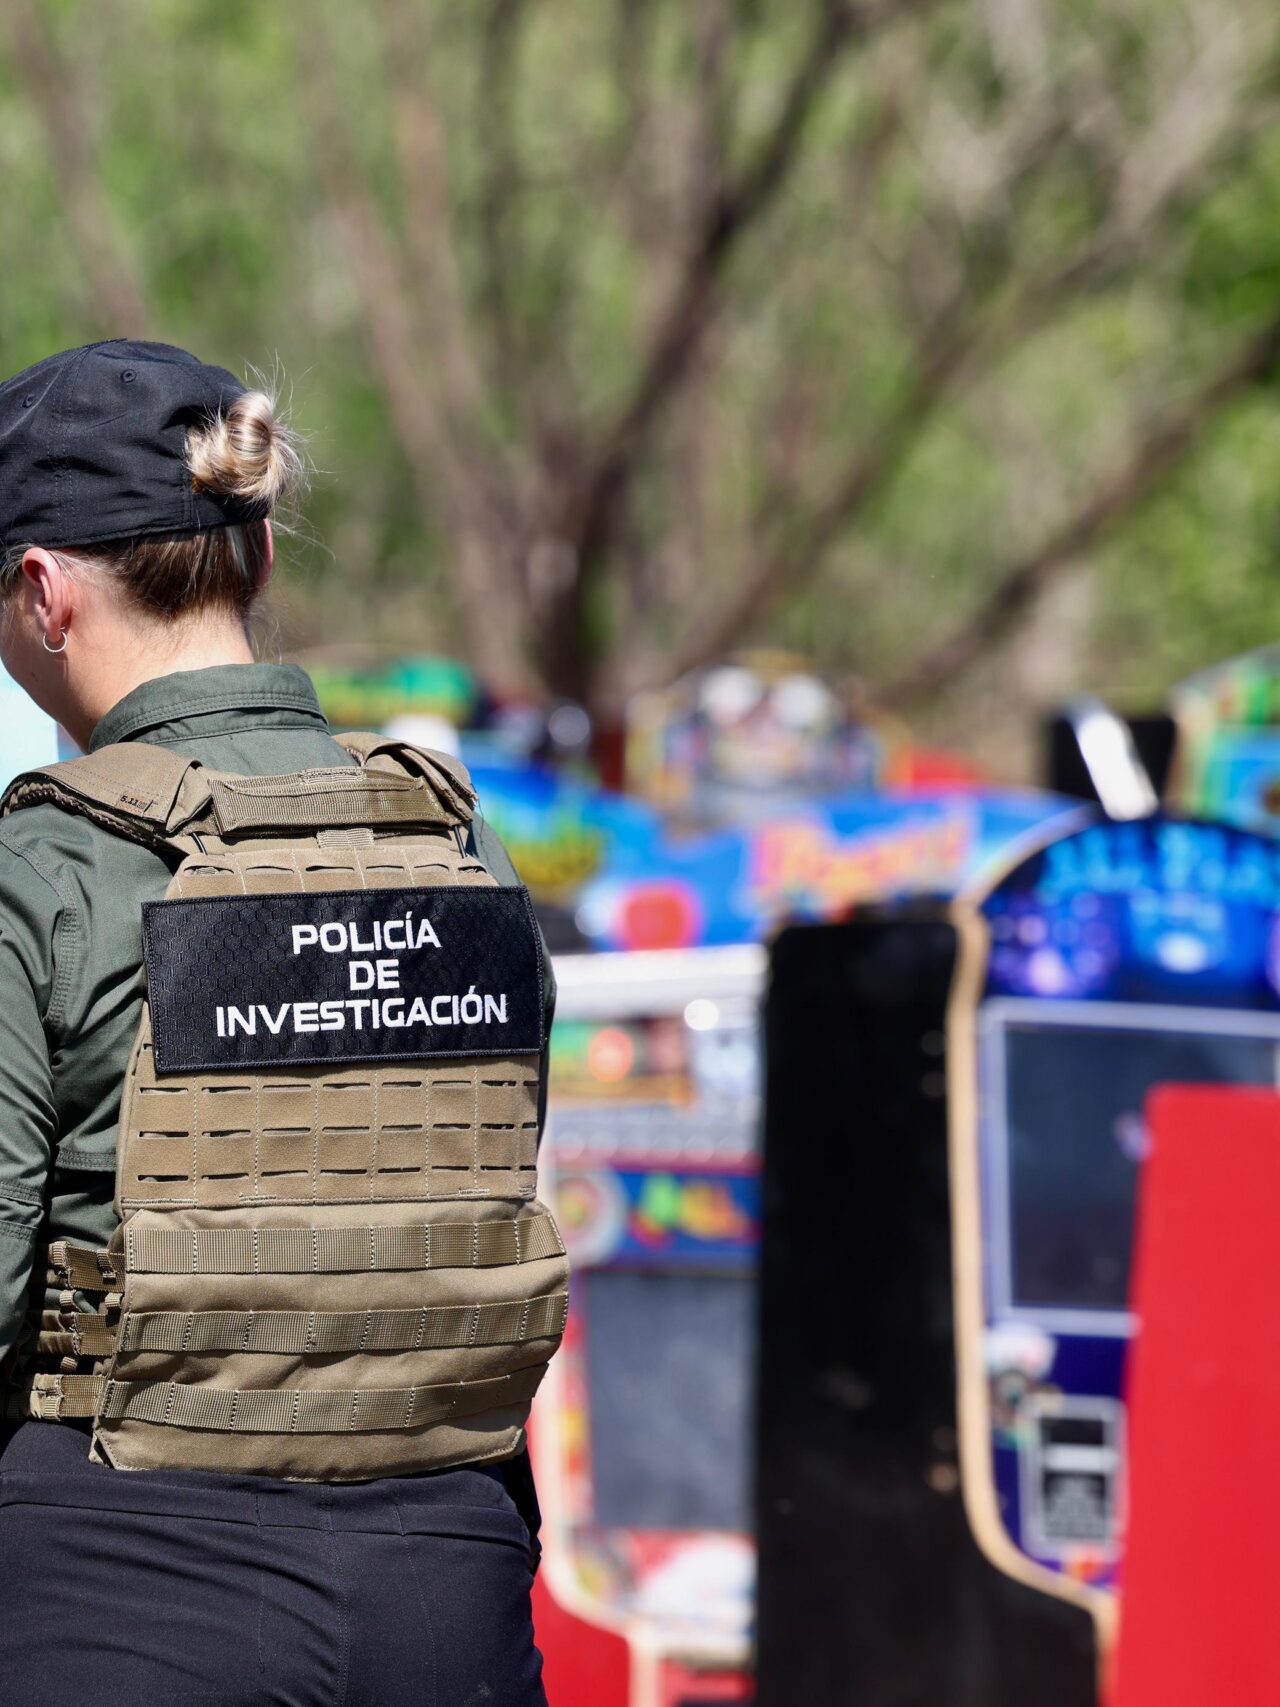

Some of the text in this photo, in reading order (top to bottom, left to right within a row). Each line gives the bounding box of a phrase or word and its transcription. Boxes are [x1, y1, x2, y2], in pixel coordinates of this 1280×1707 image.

[292, 911, 442, 954] POLICÍA
[349, 959, 400, 991] DE
[216, 986, 509, 1037] INVESTIGACIÓN
